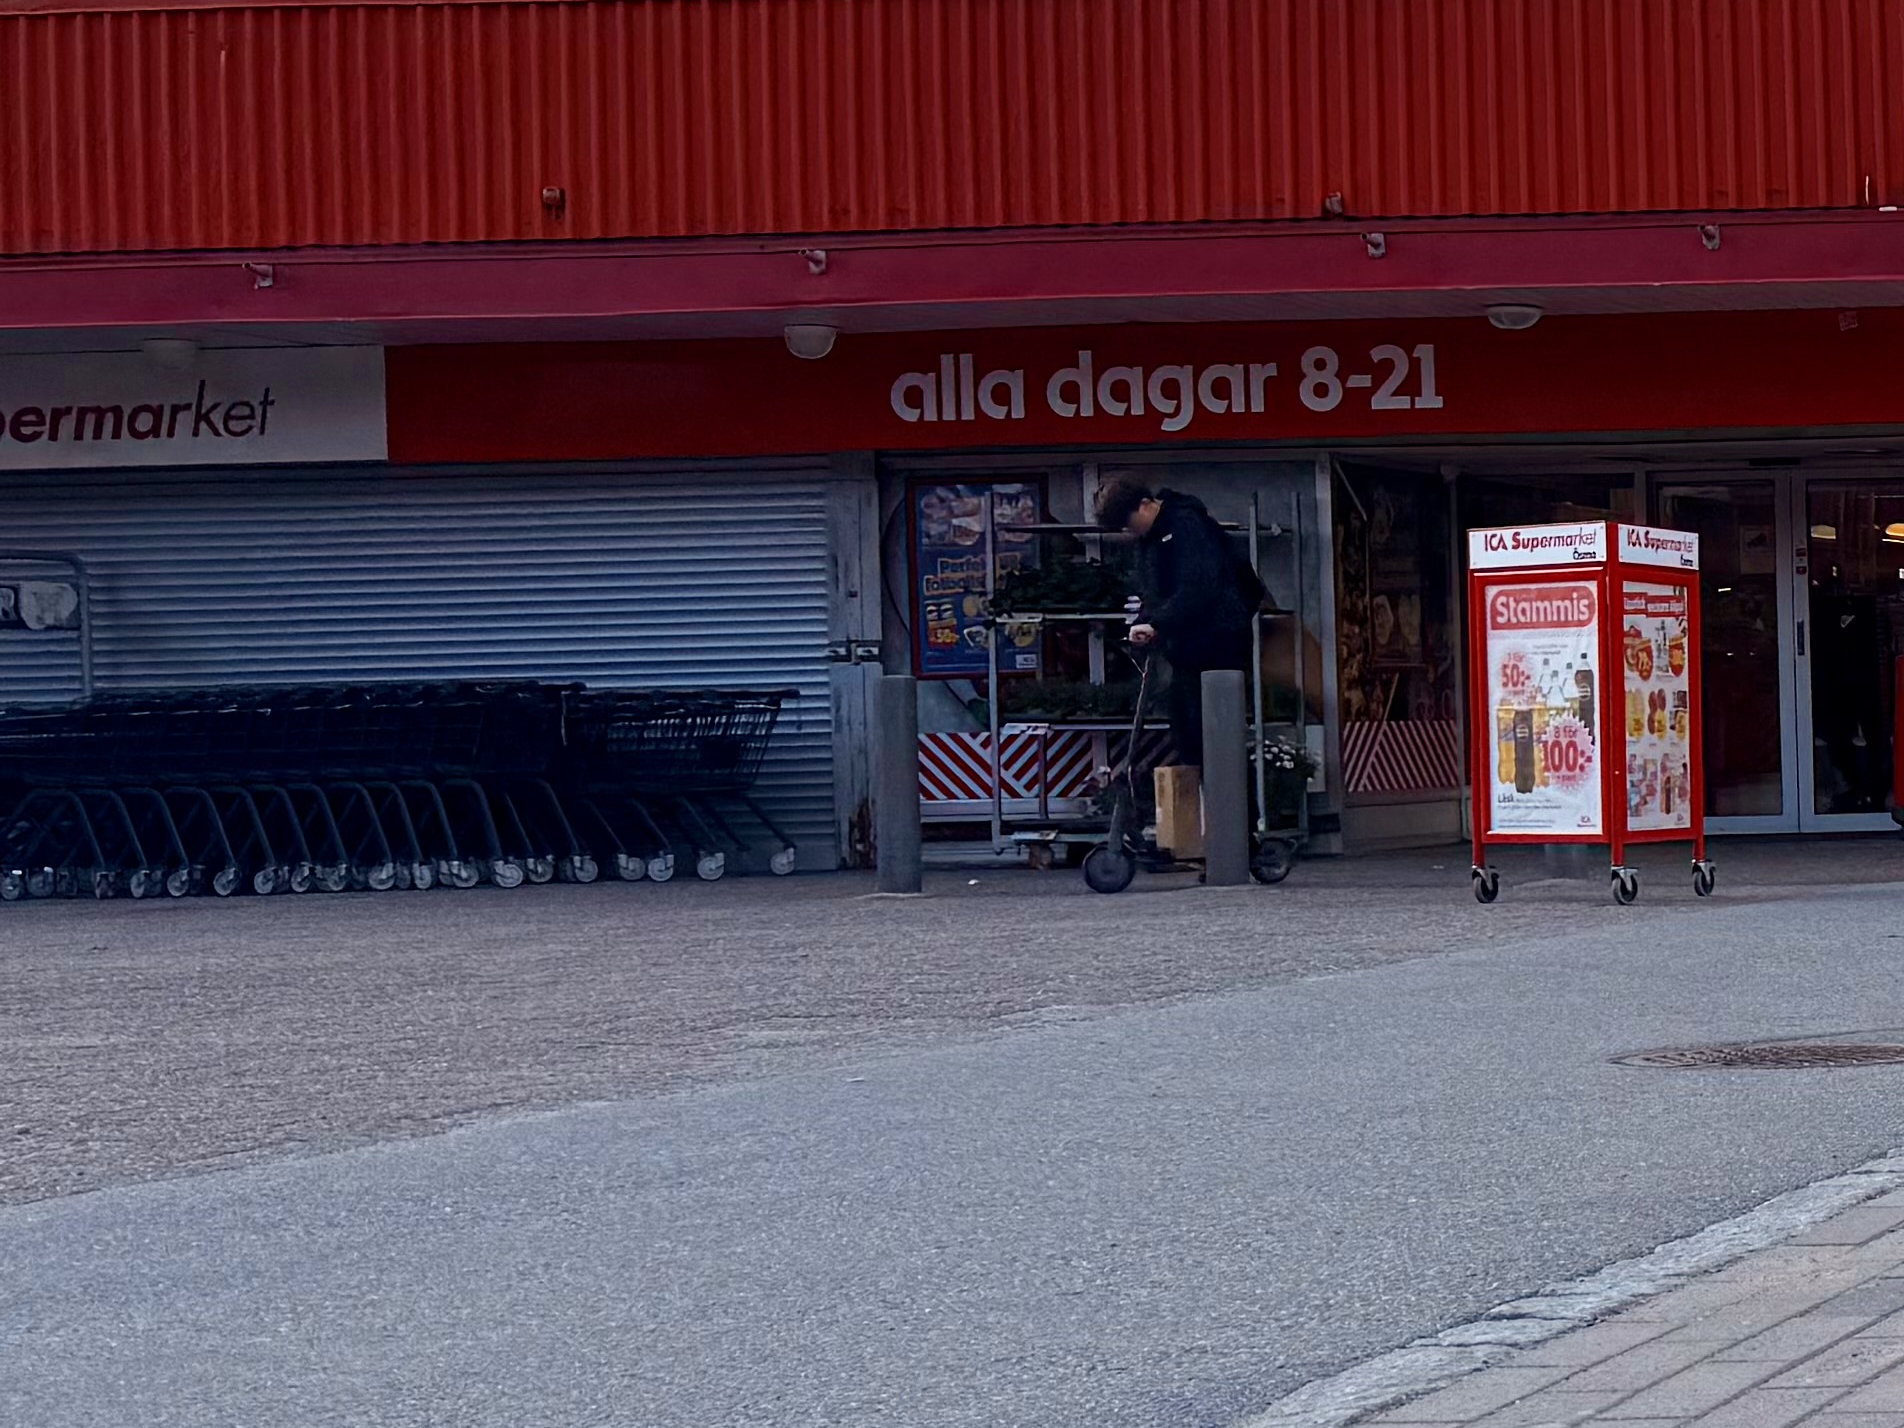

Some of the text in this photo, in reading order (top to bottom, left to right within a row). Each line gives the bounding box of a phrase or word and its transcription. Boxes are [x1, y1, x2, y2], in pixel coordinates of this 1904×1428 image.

[891, 343, 1444, 432] alla dagar 8-21
[0, 379, 275, 443] ermarket
[1484, 527, 1597, 553] ICA Supermarket
[1627, 528, 1696, 555] ICA Supermarket
[1495, 590, 1590, 625] Stammis
[1502, 663, 1531, 688] 50:-
[1563, 725, 1578, 739] för
[1541, 739, 1593, 773] 100:-
